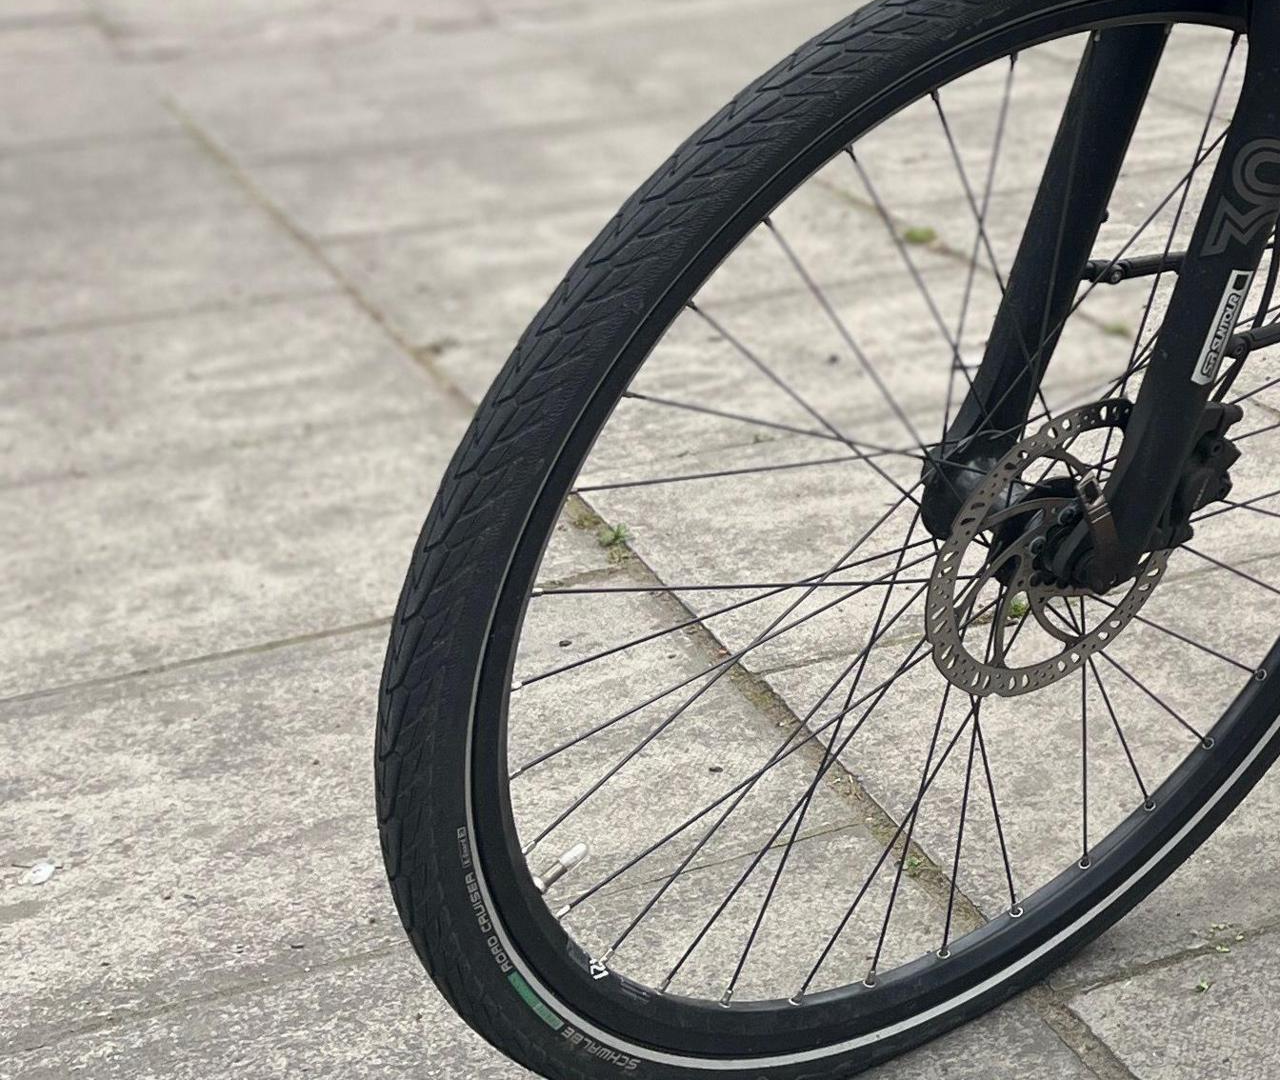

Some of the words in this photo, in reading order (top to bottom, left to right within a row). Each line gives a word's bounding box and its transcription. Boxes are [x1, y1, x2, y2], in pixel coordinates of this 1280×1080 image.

[1210, 294, 1241, 354] SUNTOUR
[463, 873, 494, 934] CRUISER
[487, 935, 514, 974] ROAD
[561, 1026, 642, 1071] SCHWALBE
